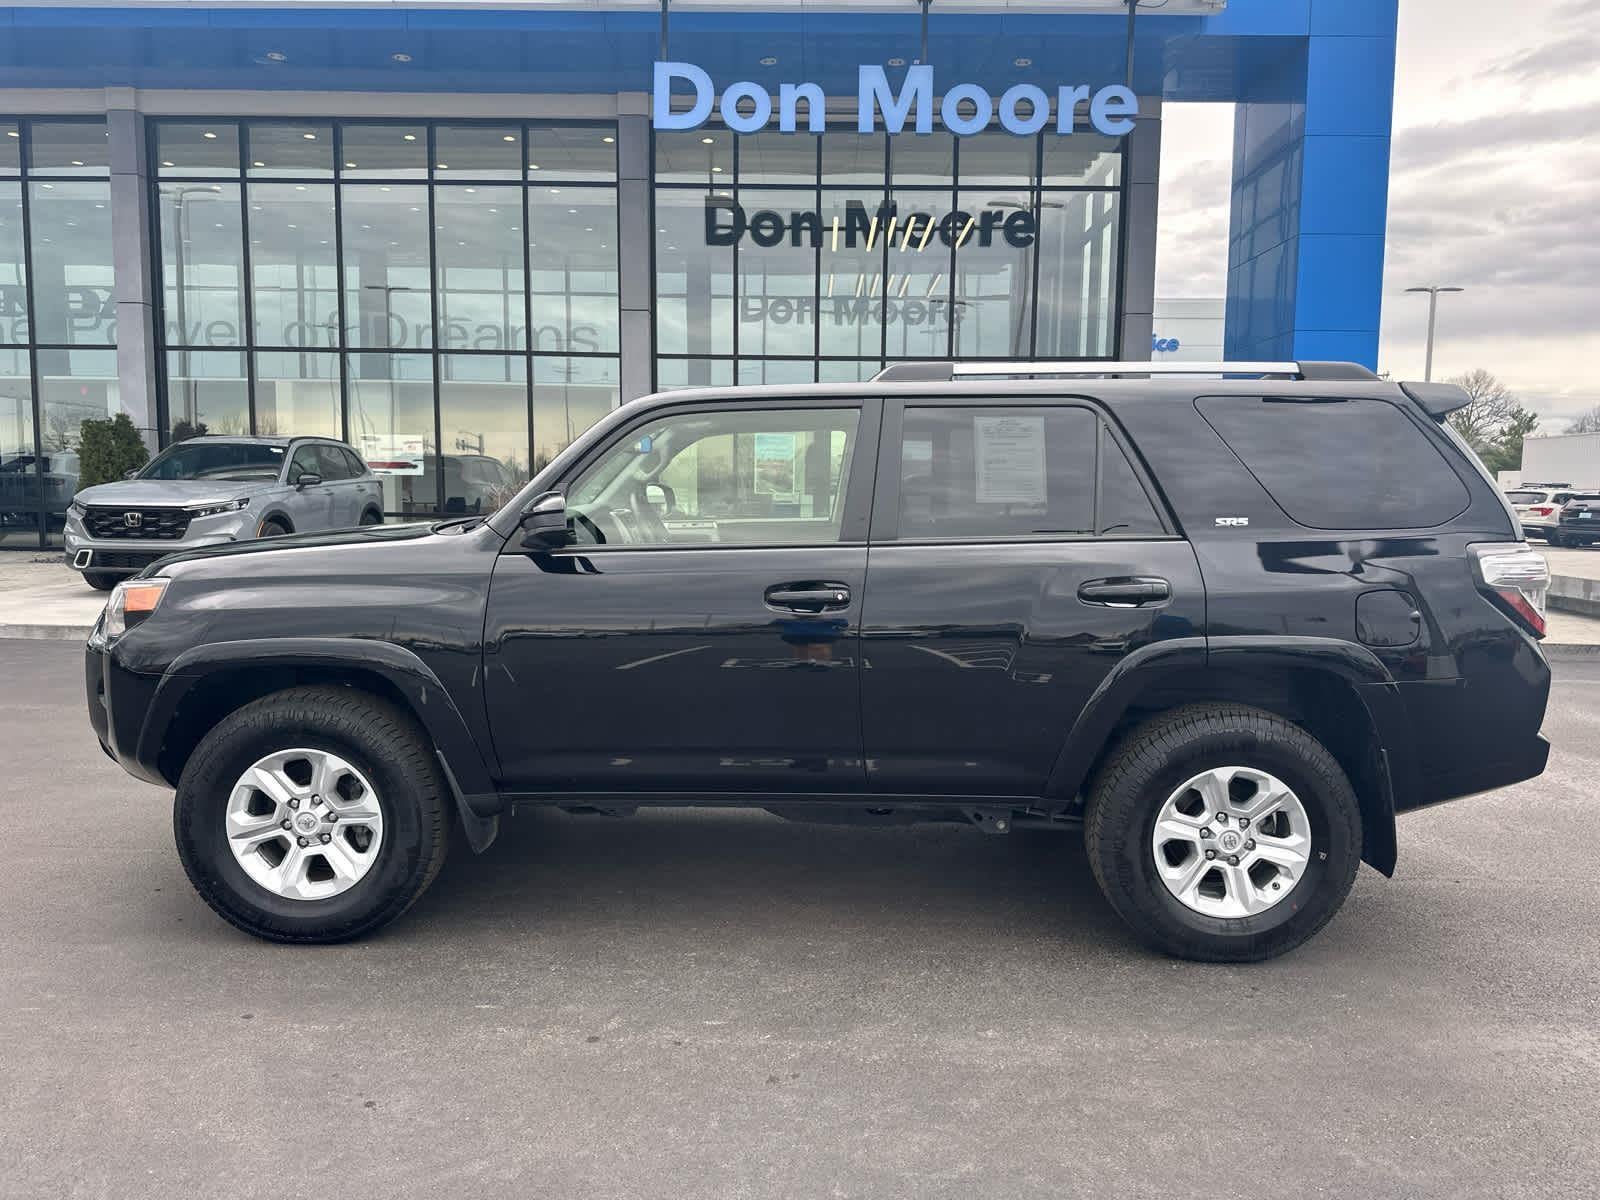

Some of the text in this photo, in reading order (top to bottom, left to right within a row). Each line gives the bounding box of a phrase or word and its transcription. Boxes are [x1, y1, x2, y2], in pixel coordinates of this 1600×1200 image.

[653, 61, 1139, 137] Don Moore
[704, 195, 1036, 248] Don Moore
[66, 313, 260, 347] Pwe
[366, 310, 602, 352] Dreams
